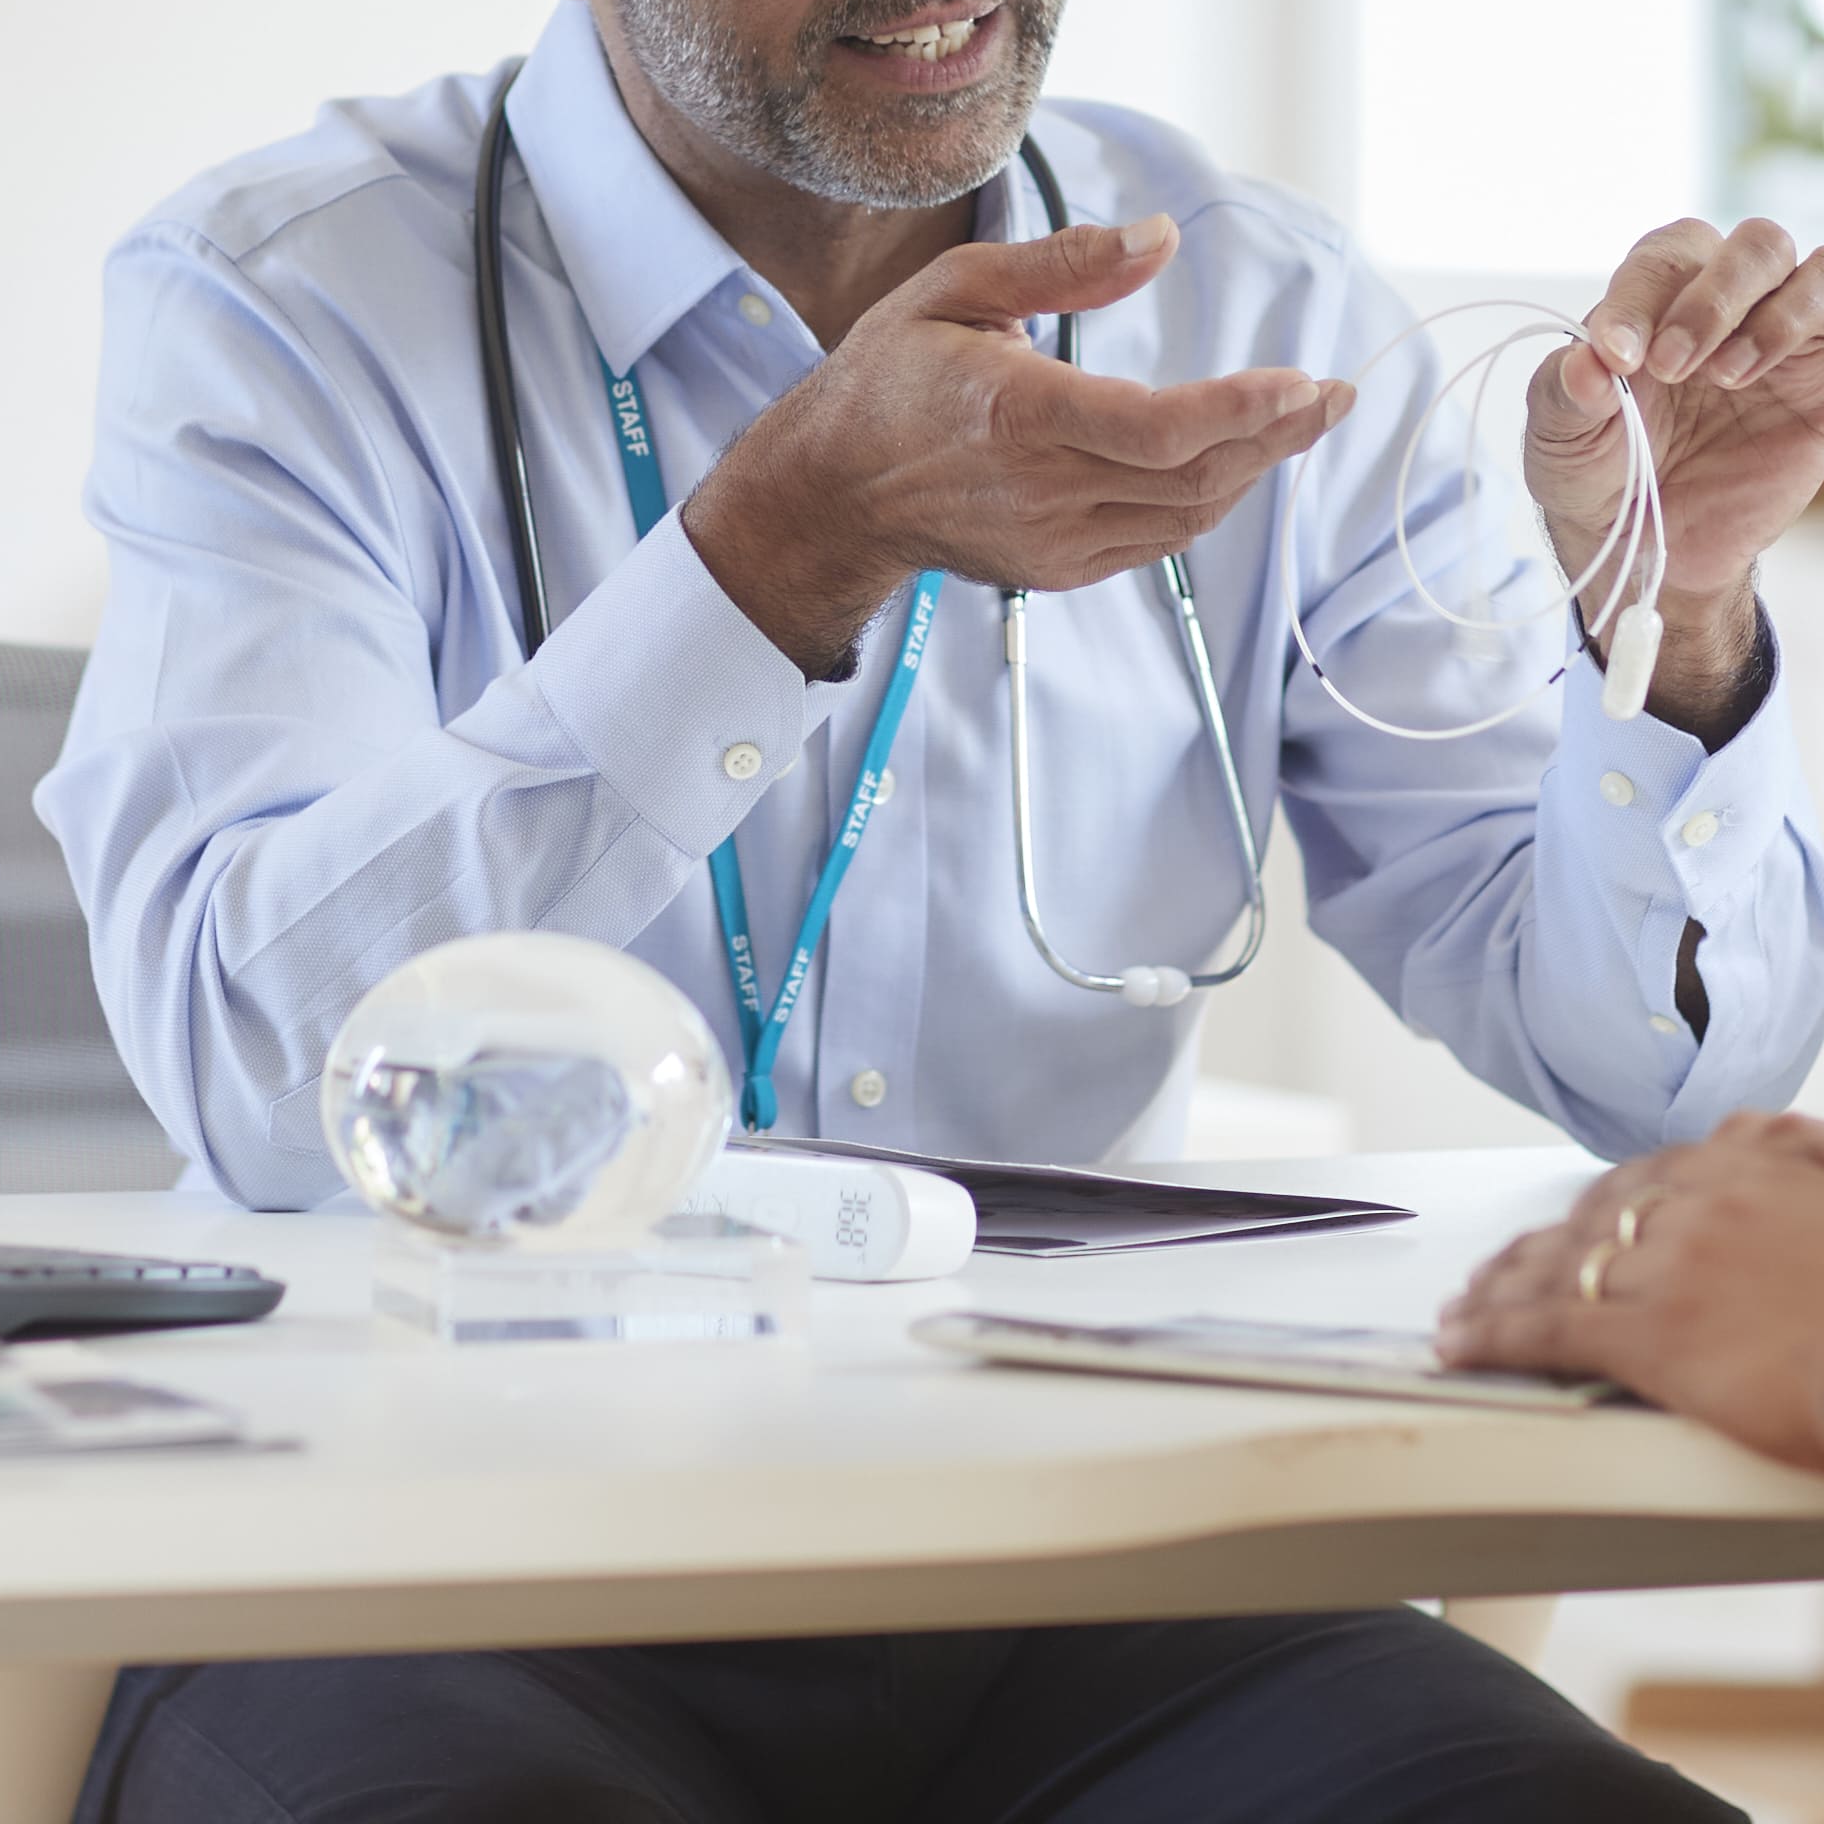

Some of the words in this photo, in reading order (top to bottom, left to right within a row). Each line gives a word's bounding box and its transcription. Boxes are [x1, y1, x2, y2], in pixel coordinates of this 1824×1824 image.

[612, 380, 650, 456] STAFF
[903, 592, 935, 671] STAFF
[842, 769, 878, 849] STAFF
[732, 934, 760, 1012] STAFF
[773, 947, 810, 1024] STAFF
